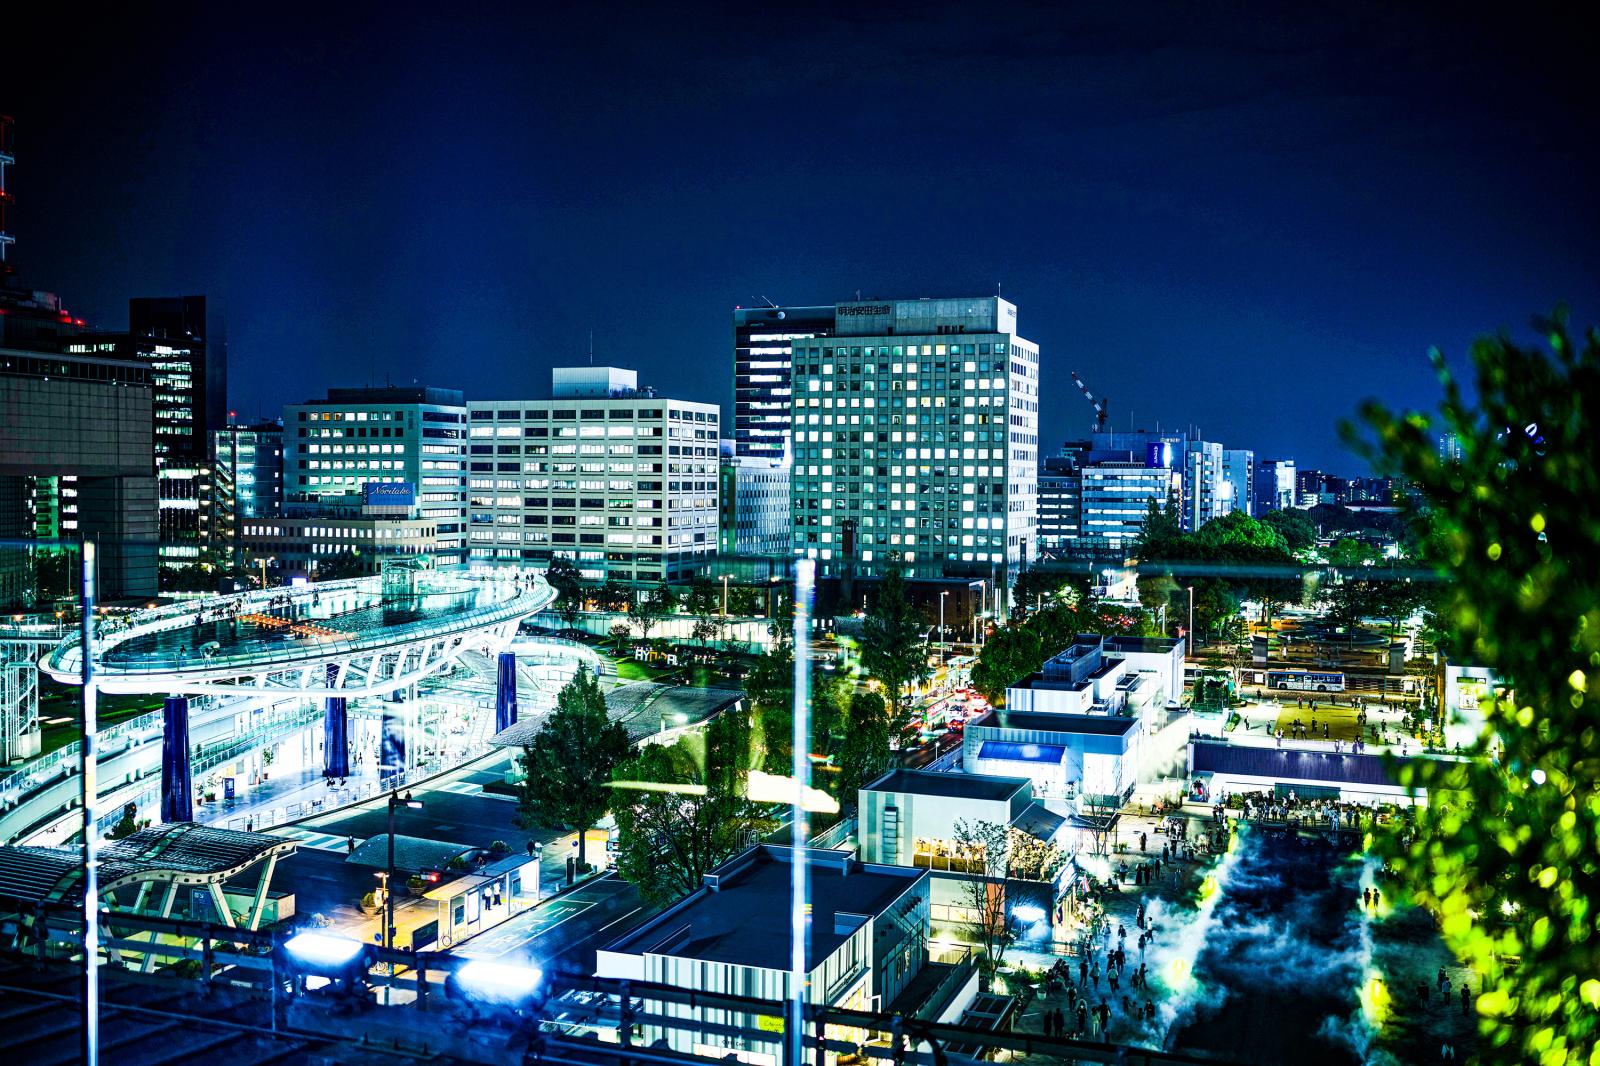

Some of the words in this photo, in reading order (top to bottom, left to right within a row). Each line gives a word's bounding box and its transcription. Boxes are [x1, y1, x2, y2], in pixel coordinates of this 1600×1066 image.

[838, 305, 892, 316] 明治安田生命
[370, 484, 411, 495] Noritake
